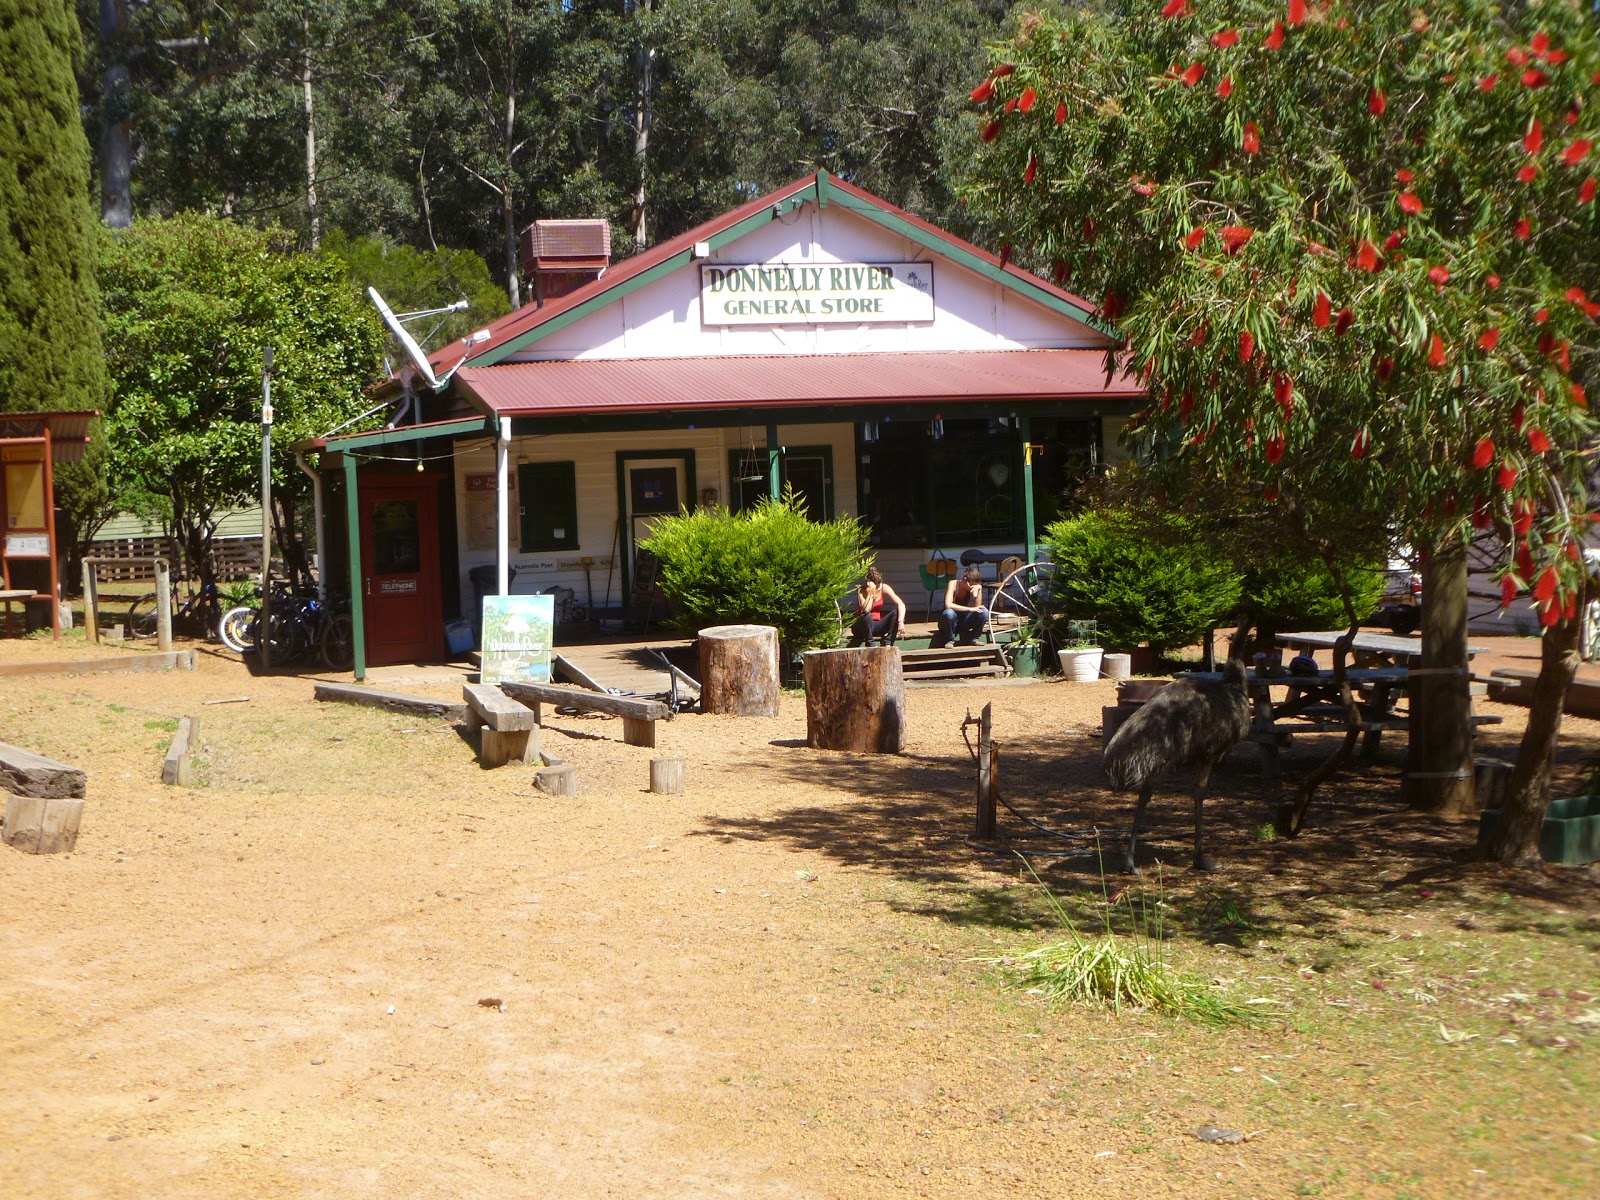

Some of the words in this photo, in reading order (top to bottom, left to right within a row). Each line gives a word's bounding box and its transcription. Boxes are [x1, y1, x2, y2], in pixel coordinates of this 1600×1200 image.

[709, 267, 824, 293] DONNELLY
[830, 266, 895, 291] RIVER
[723, 299, 817, 316] GENERAL
[821, 298, 884, 314] STORE
[381, 582, 415, 590] TELEPHONE
